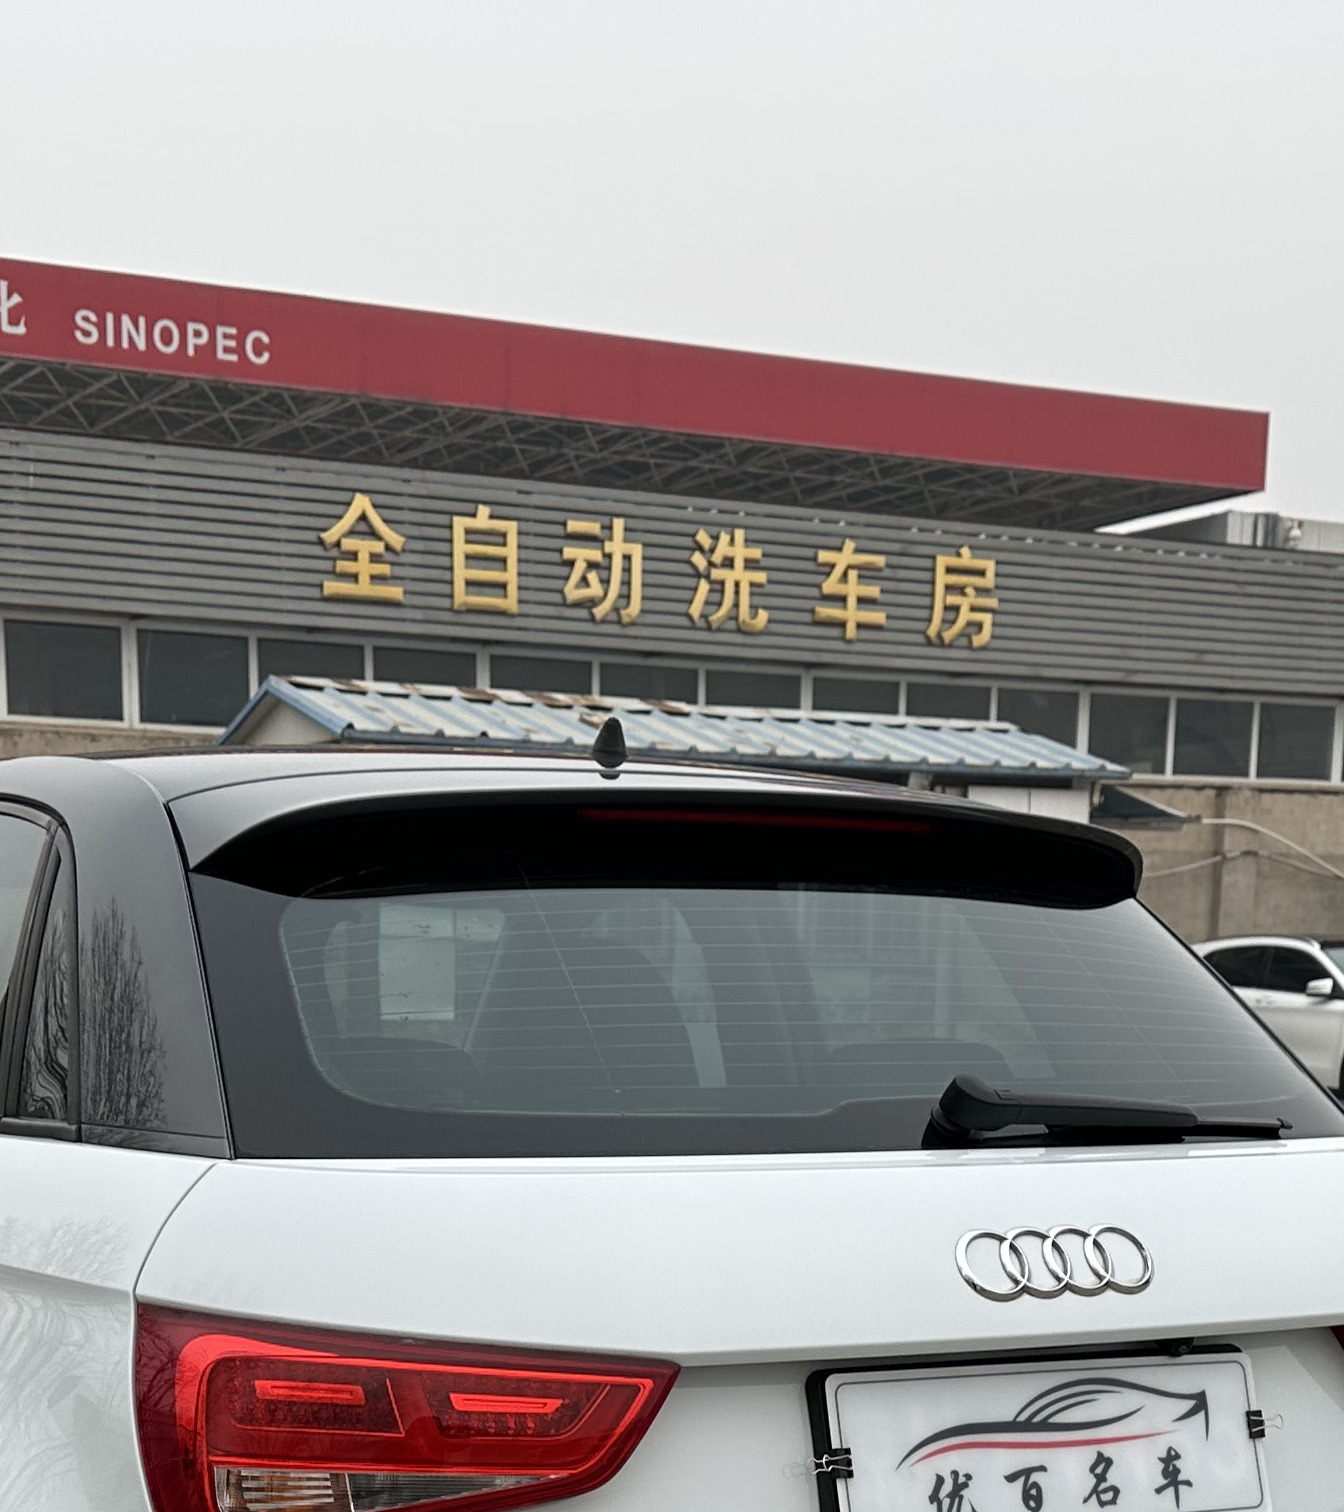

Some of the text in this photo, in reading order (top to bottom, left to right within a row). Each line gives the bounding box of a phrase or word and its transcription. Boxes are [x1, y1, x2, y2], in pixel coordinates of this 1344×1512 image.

[72, 308, 273, 366] SINOPEC
[319, 492, 999, 648] 全自动洗车房
